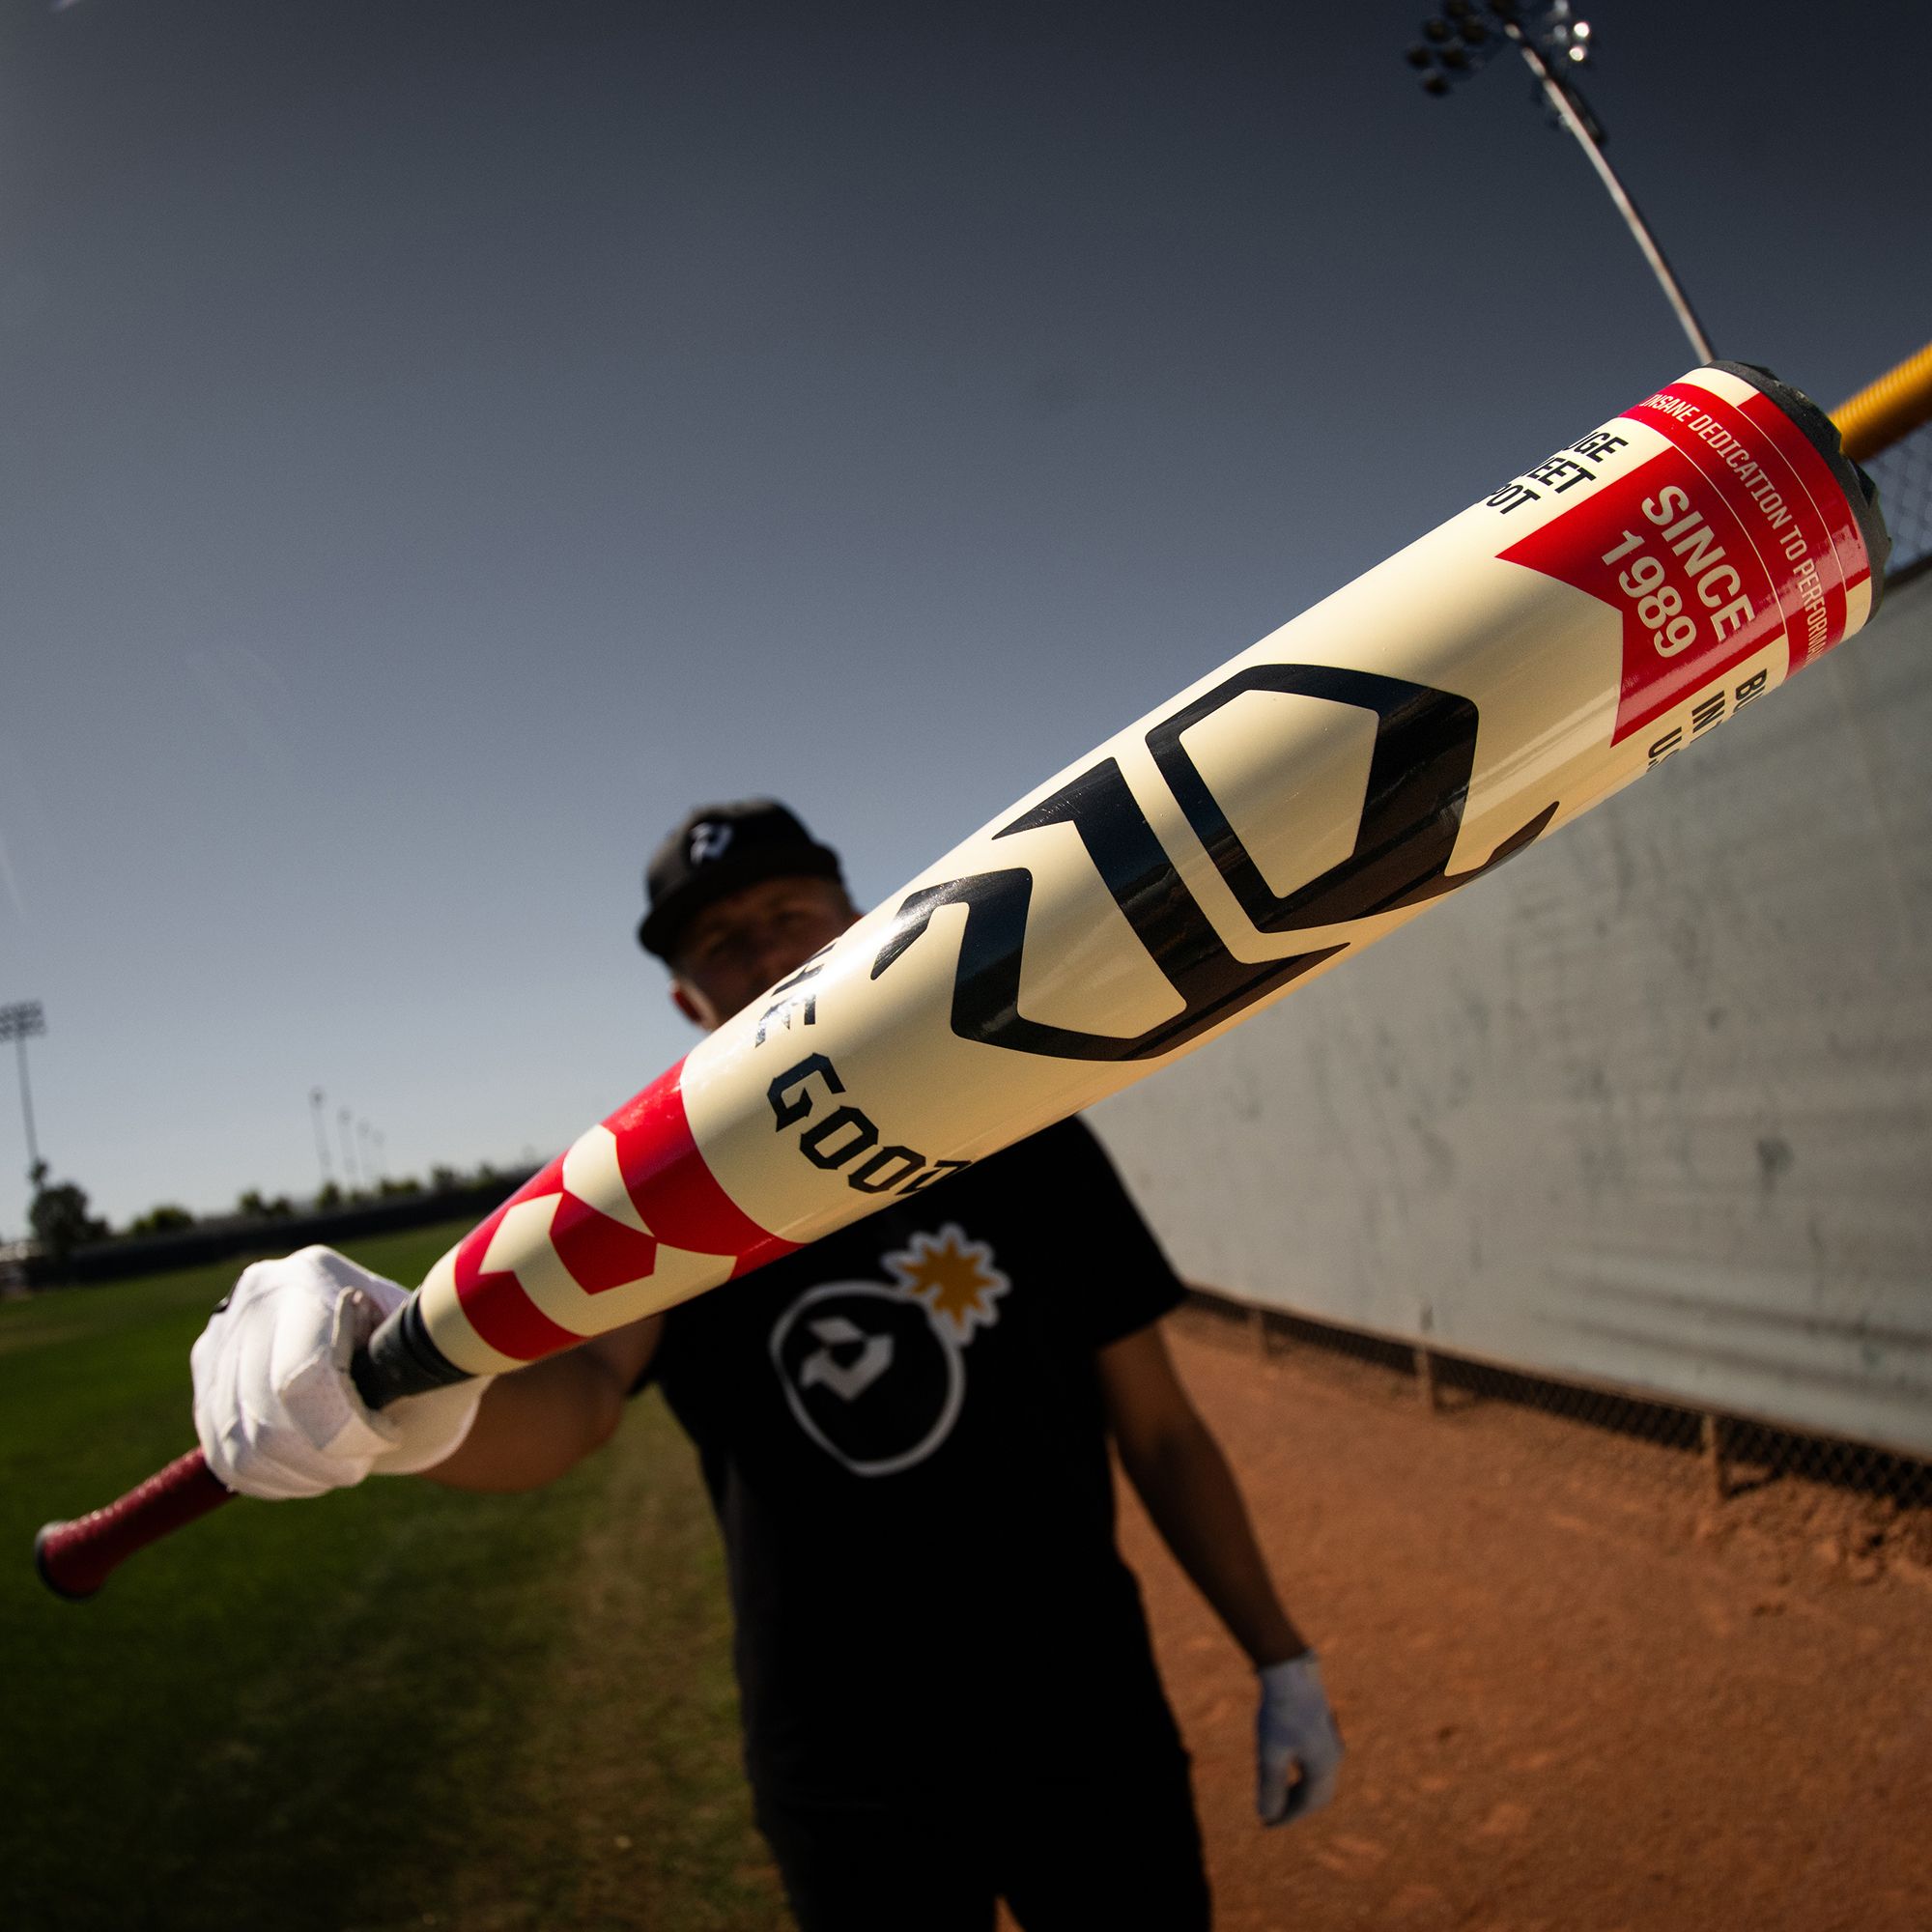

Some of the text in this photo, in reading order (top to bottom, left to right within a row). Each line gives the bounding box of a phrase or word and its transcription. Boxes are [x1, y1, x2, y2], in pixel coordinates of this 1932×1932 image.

[1520, 457, 1598, 494] EET
[1639, 394, 1700, 422] INSANE
[1688, 414, 1792, 529] DEDICATION
[1779, 525, 1807, 561] TO
[1602, 529, 1697, 659] 1989
[1641, 486, 1756, 642] SINCE
